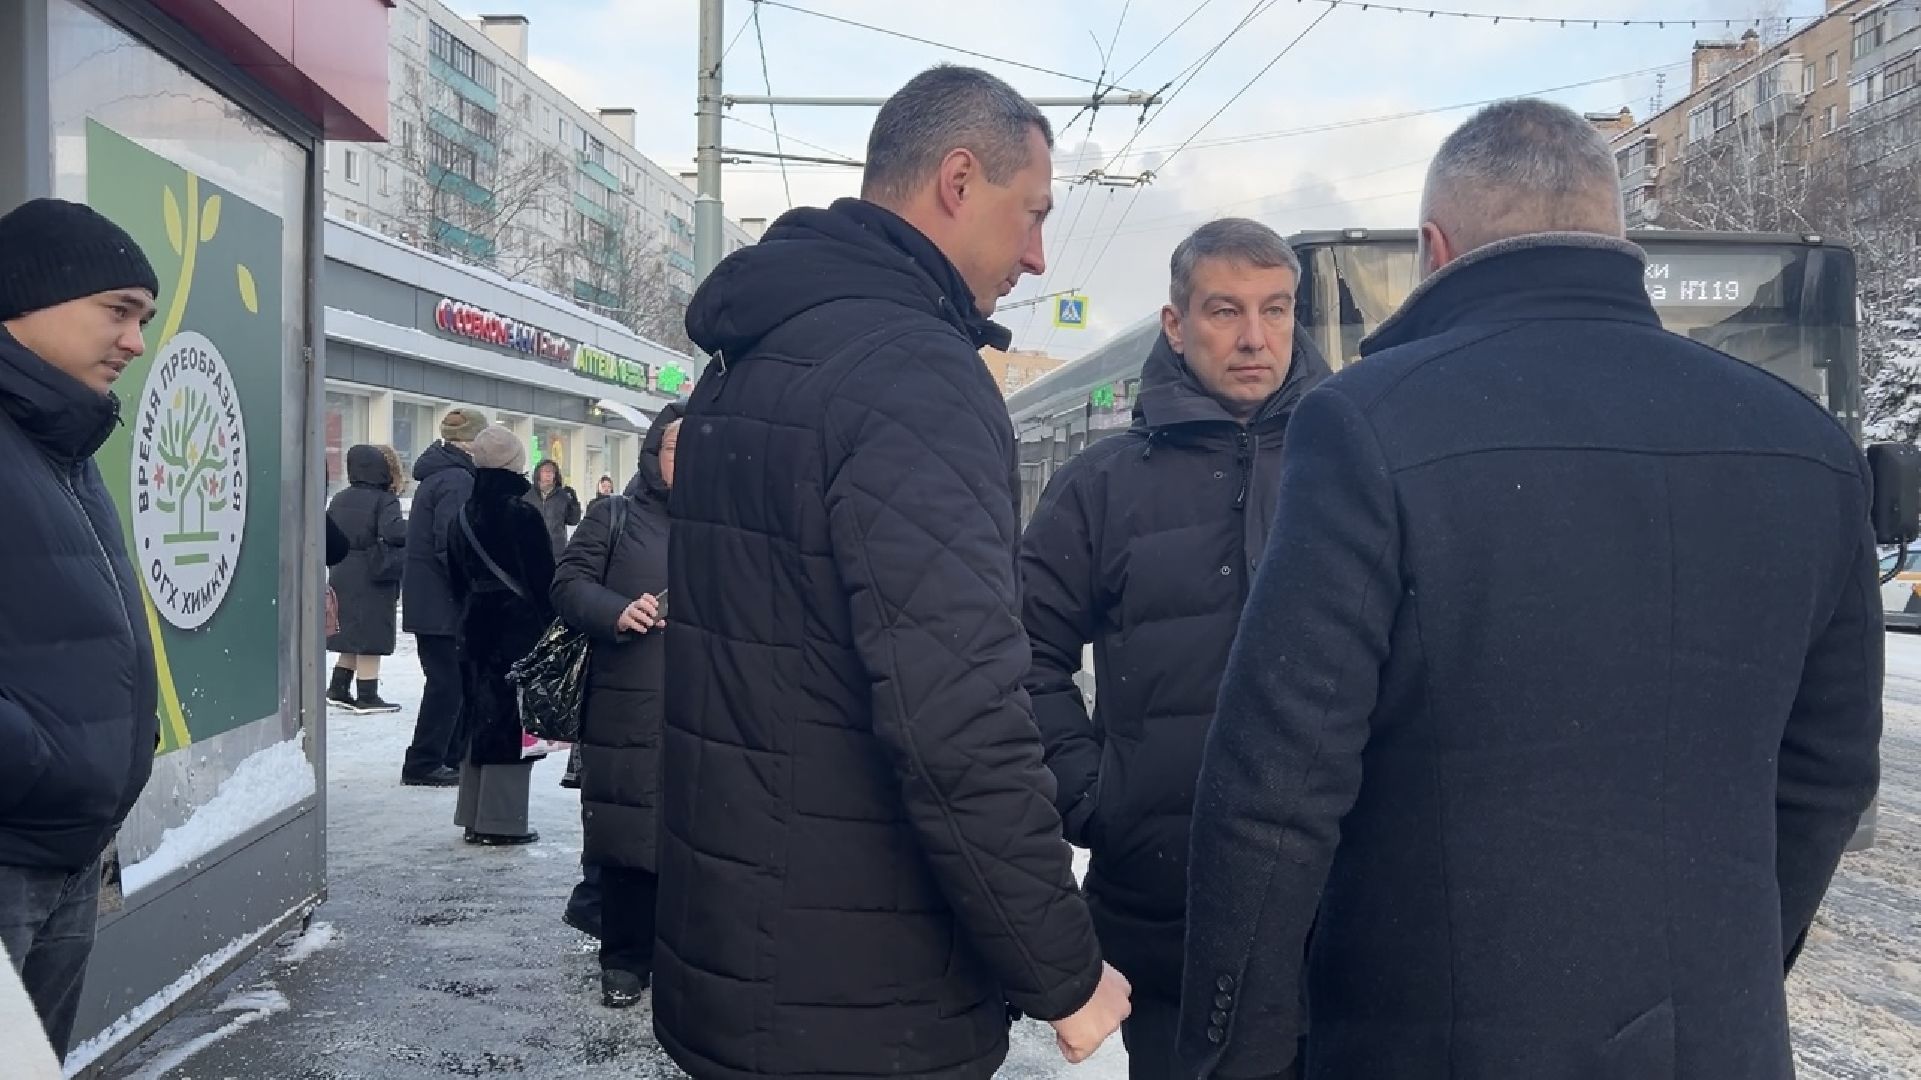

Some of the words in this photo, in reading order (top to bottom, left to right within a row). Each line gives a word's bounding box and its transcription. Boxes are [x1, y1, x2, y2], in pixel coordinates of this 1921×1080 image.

[138, 387, 161, 513] ВРЕМЯ
[160, 347, 242, 512] ПРЕОБРАЗИТЬСЯ
[151, 558, 177, 609] ОГХ
[181, 553, 228, 614] ХИМКИ
